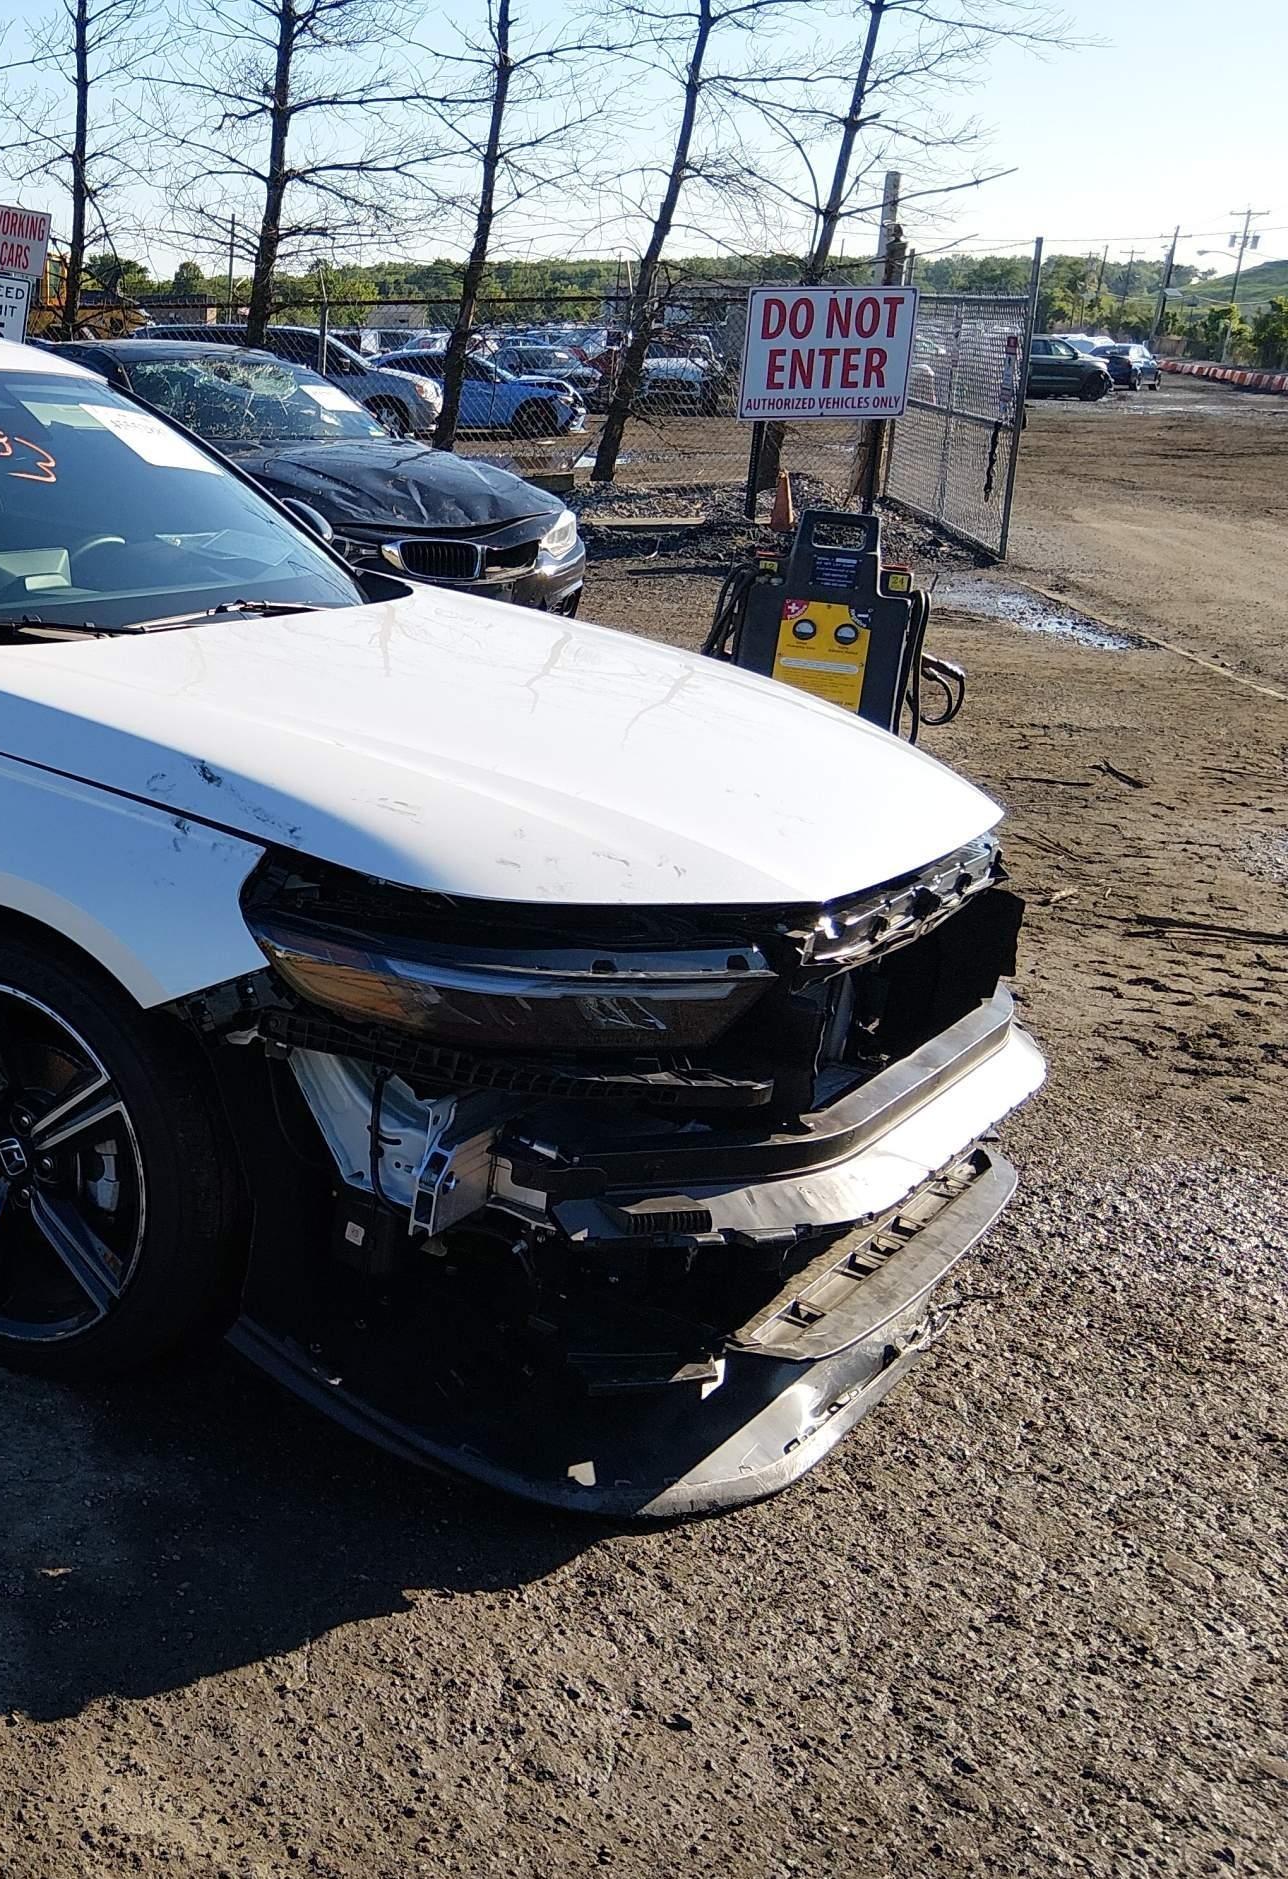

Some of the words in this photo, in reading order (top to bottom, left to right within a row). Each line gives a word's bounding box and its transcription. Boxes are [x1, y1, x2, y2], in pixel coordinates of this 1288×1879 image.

[0, 242, 31, 270] CARS
[761, 297, 815, 340] DO
[825, 296, 905, 339] NOT
[766, 347, 888, 390] ENTER
[745, 397, 816, 411] AUTHORIZED
[818, 396, 870, 409] VEHICLES
[873, 395, 901, 409] ONLY
